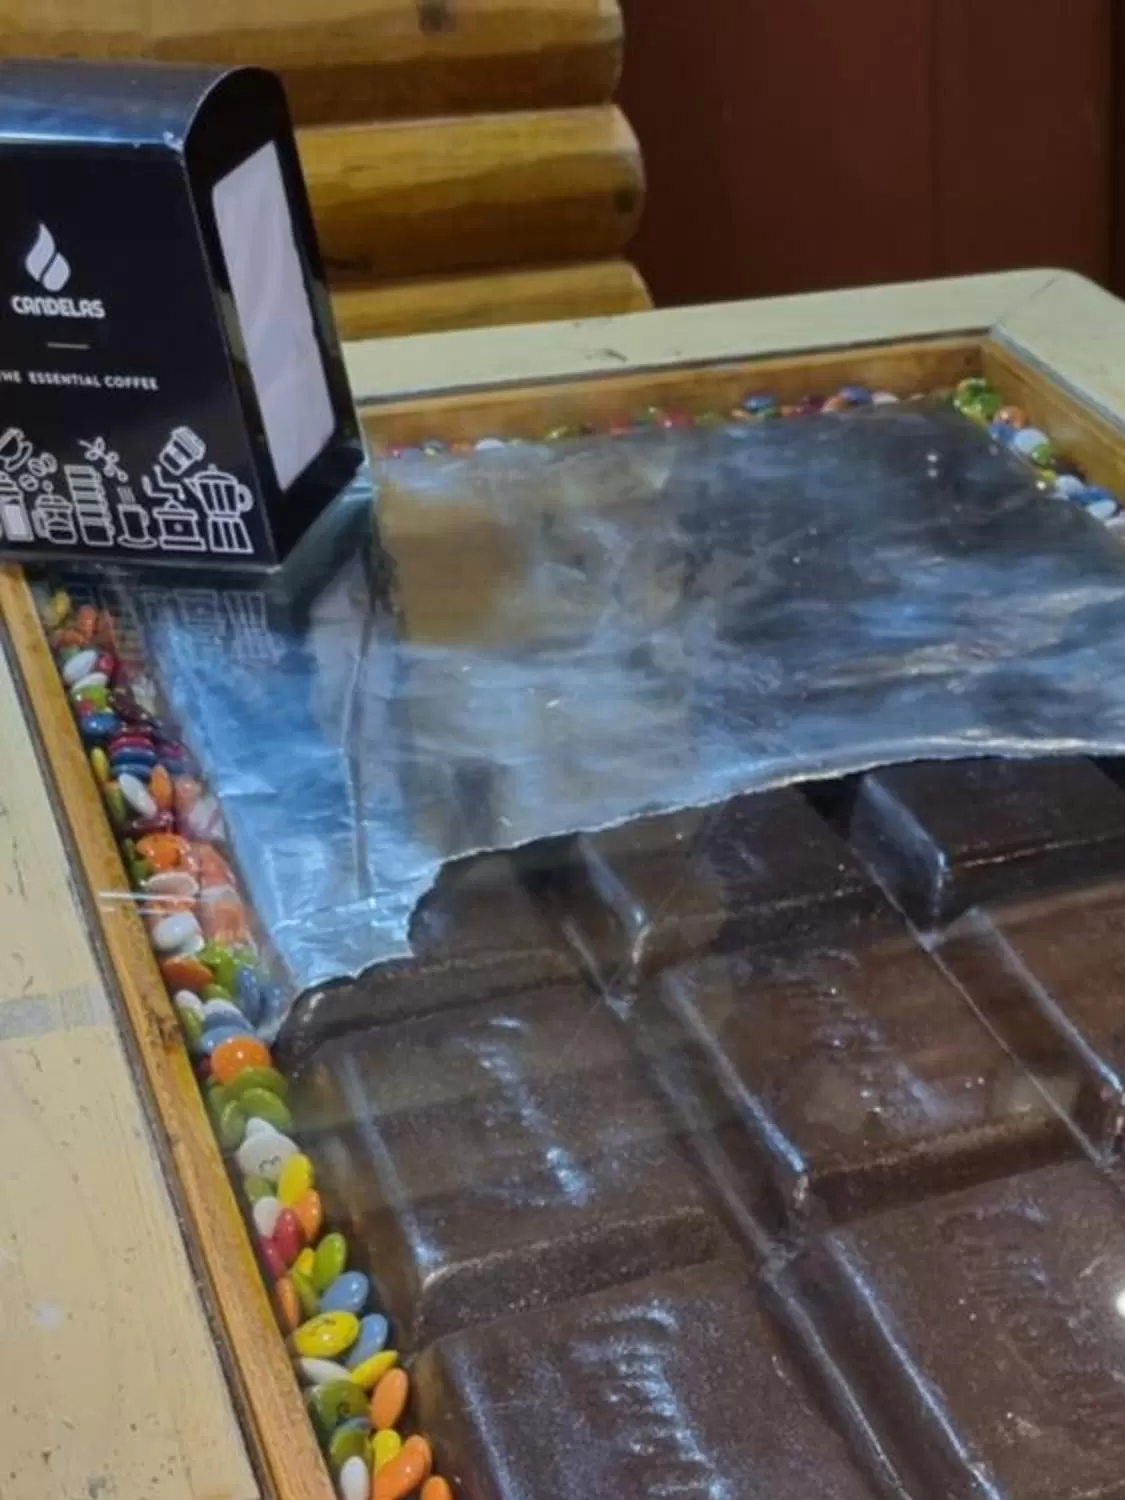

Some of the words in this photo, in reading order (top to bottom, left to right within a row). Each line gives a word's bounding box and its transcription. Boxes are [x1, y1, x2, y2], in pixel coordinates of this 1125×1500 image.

[11, 295, 106, 319] CANDELAS
[27, 370, 101, 388] ESSENTIAL
[103, 374, 159, 391] COFFEE
